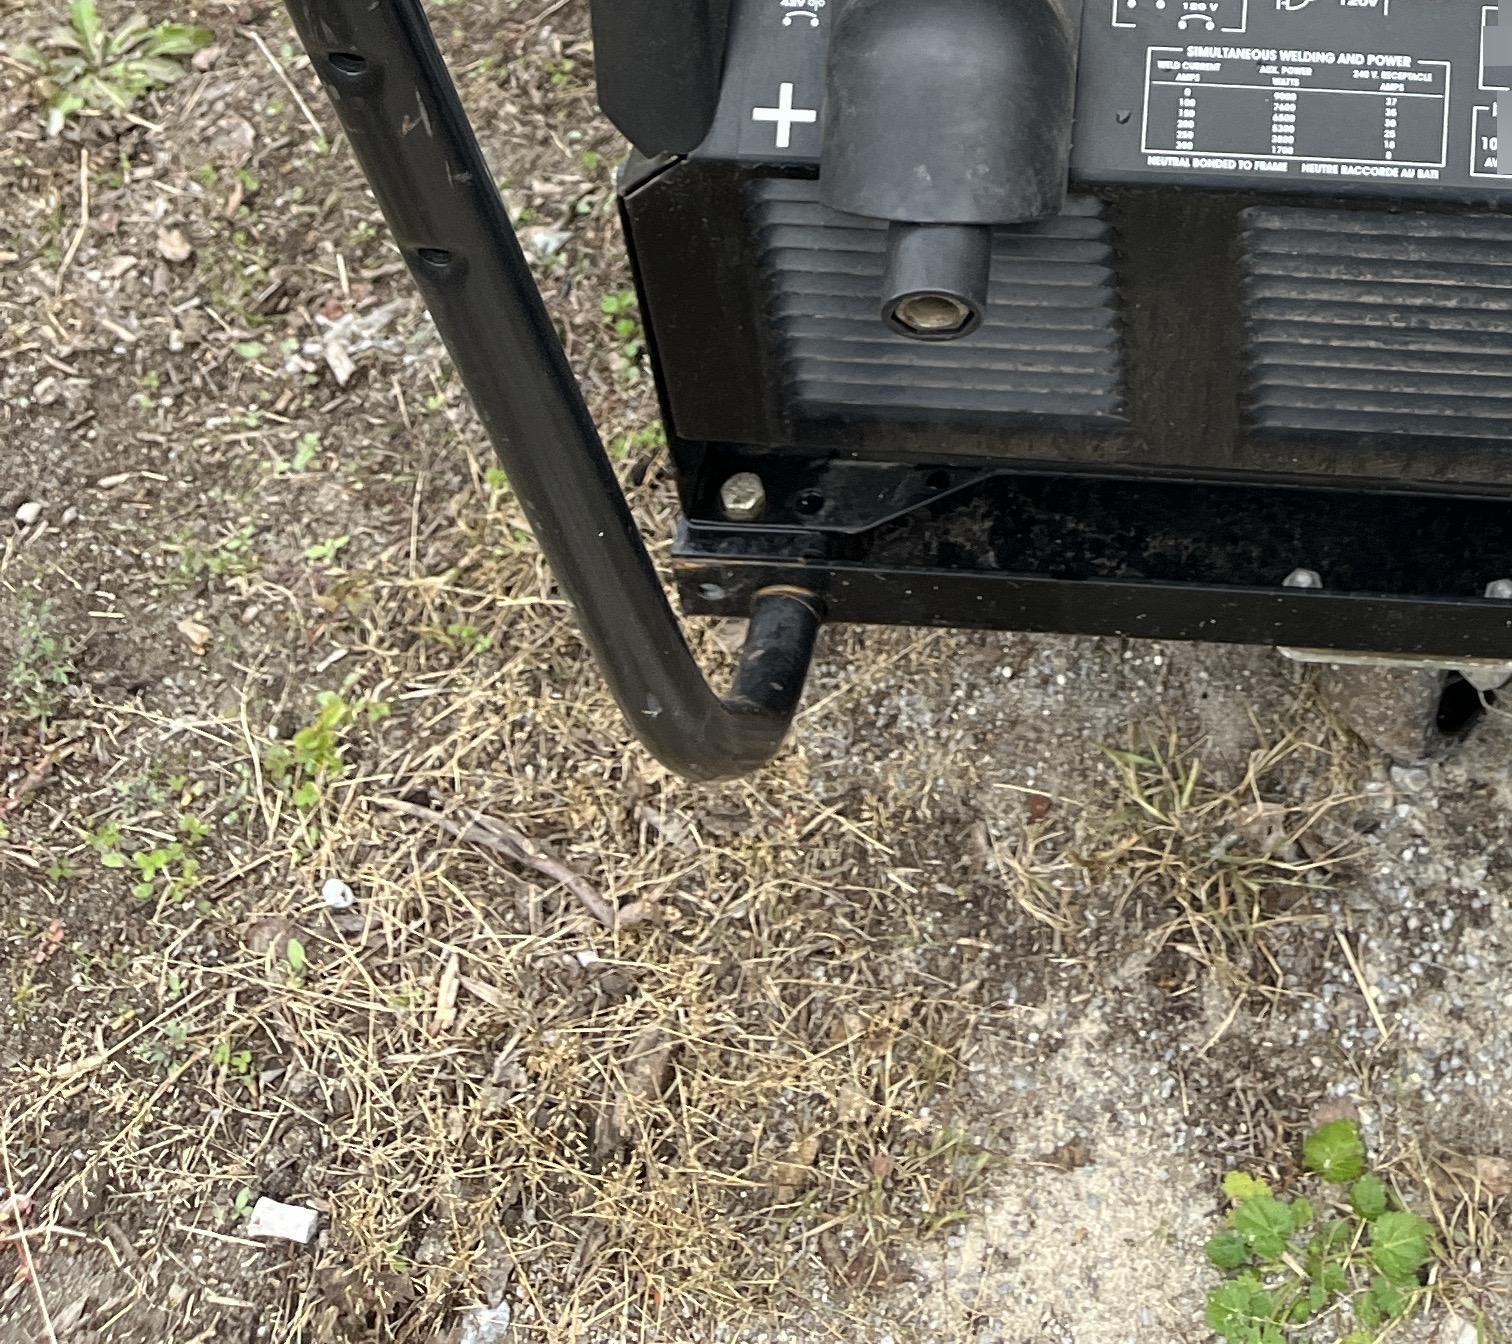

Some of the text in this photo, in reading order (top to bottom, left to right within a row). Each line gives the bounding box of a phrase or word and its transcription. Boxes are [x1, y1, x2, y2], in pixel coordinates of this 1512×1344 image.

[1209, 2, 1219, 11] V
[1186, 45, 1412, 67] SIMULTANEOUS WELDING AND POWER
[1175, 73, 1200, 82] AMPS
[1272, 77, 1300, 87] WATTS
[1379, 82, 1405, 93] AMPS
[1147, 156, 1288, 172] NEUTRAL BONDED TO FRAME
[1301, 162, 1339, 174] NEUTRE
[1341, 164, 1399, 177] RACCORDE
[1400, 167, 1416, 179] AU
